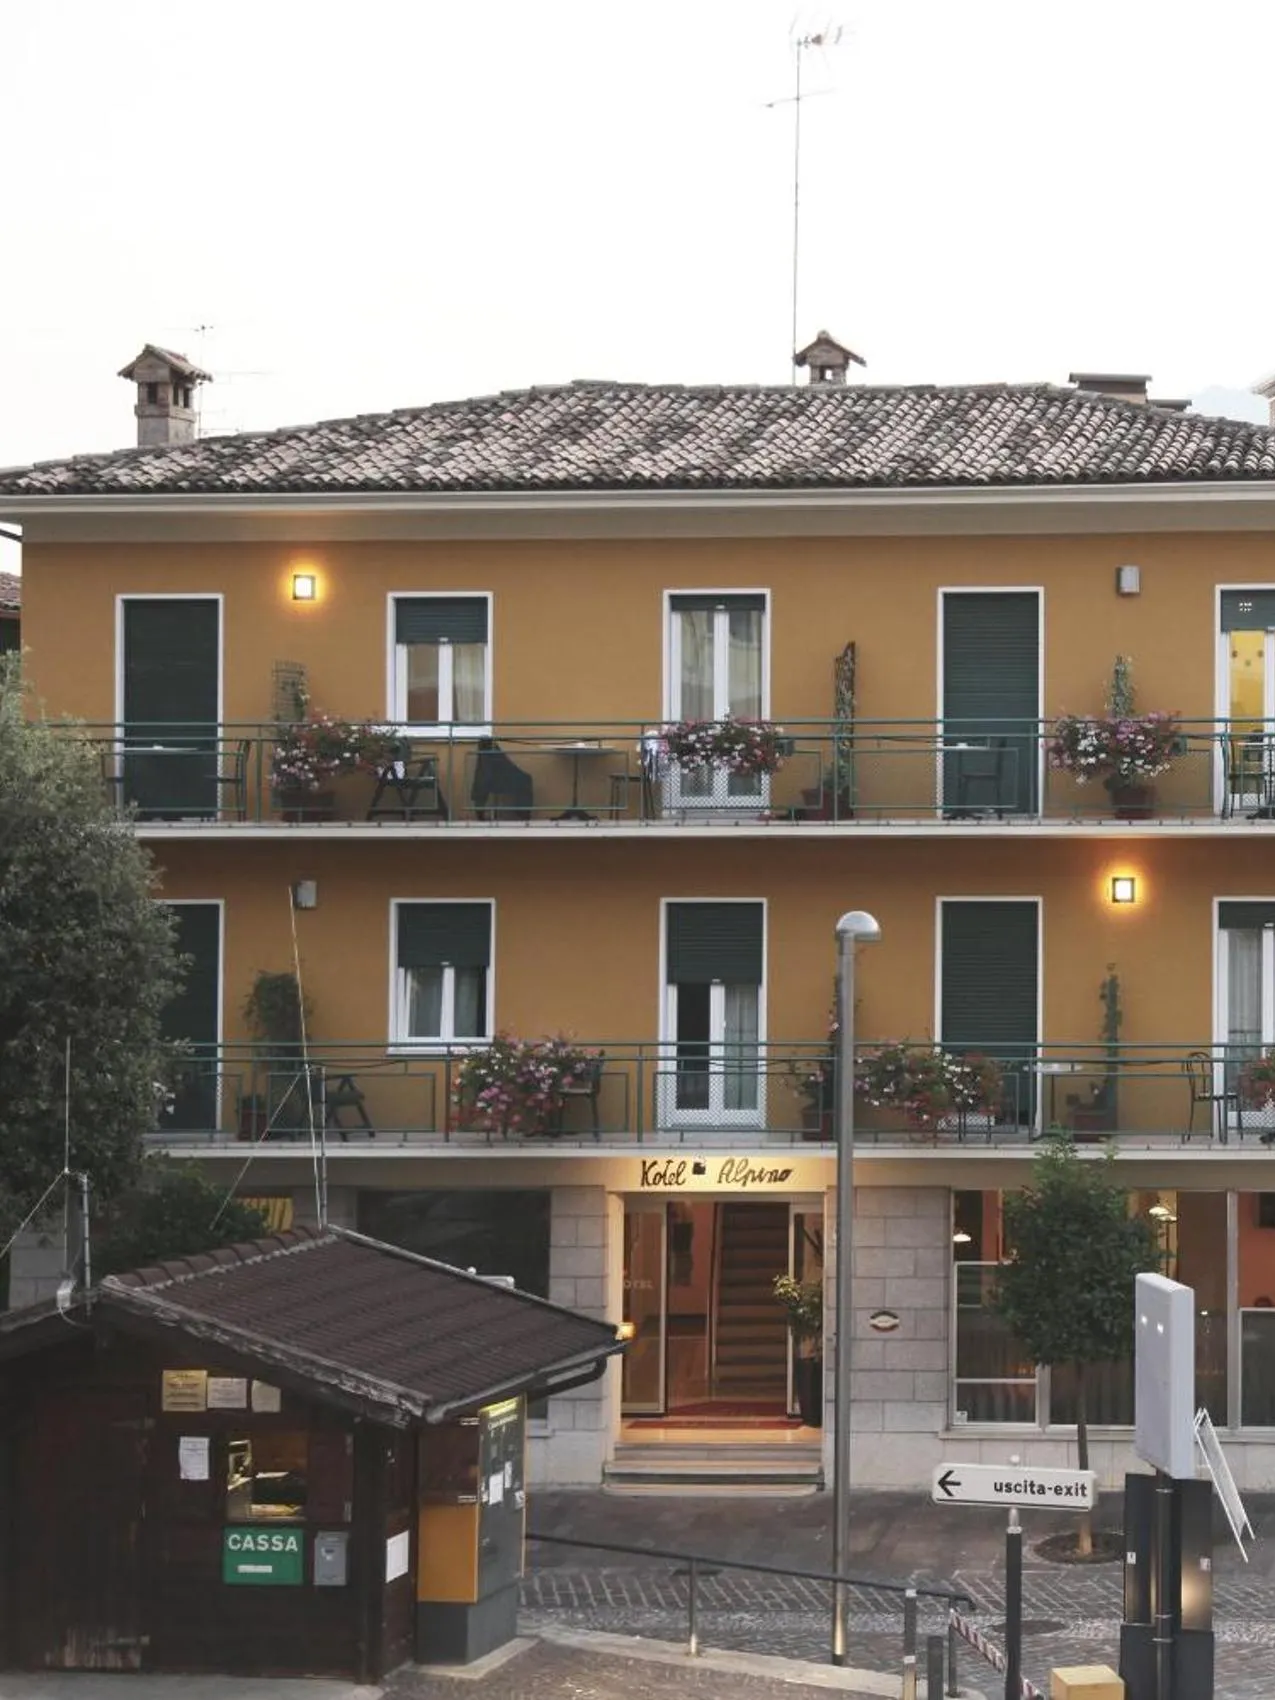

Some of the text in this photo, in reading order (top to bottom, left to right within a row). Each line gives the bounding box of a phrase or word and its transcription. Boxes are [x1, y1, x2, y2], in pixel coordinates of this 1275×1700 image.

[716, 1157, 794, 1187] Alpino
[993, 1479, 1089, 1498] uscita-exit
[227, 1533, 299, 1552] CASSA
